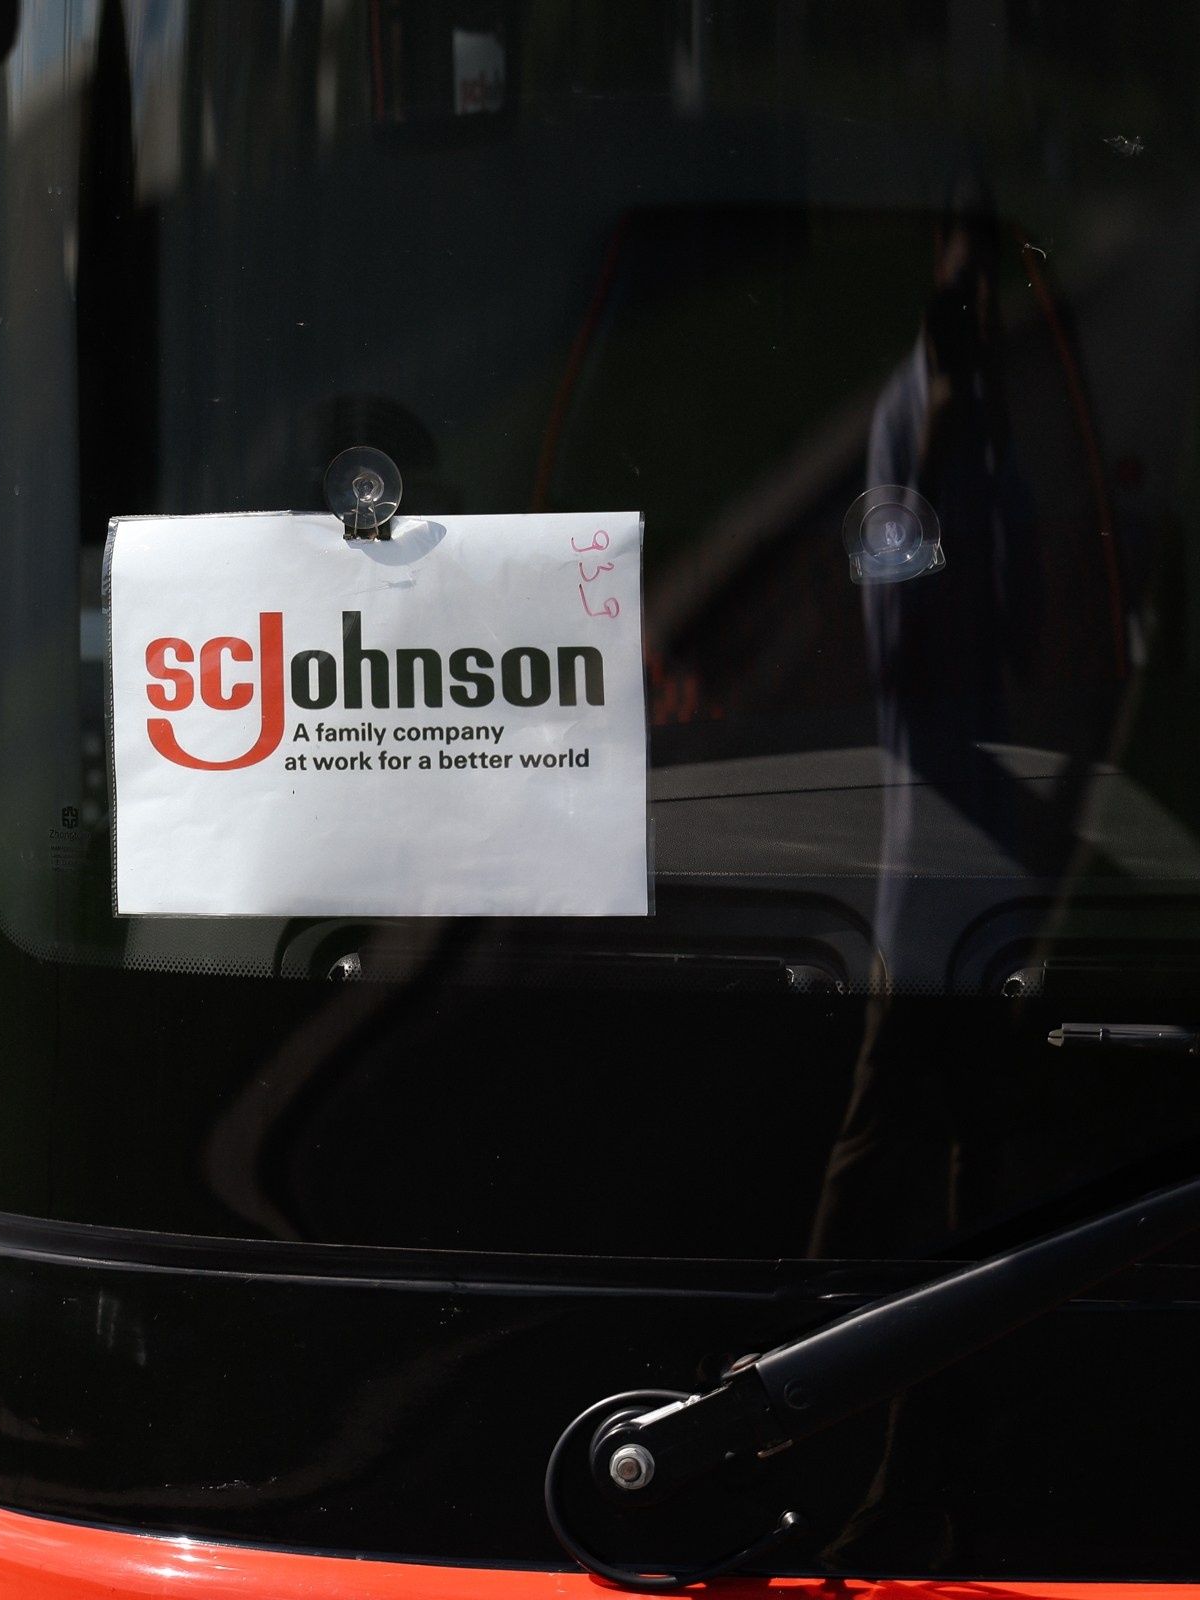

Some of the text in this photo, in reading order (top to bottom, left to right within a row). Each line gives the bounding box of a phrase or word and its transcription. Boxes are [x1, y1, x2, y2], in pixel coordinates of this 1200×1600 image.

[571, 529, 620, 619] 939
[293, 722, 505, 746] A family company
[284, 748, 590, 771] at work for a better world
